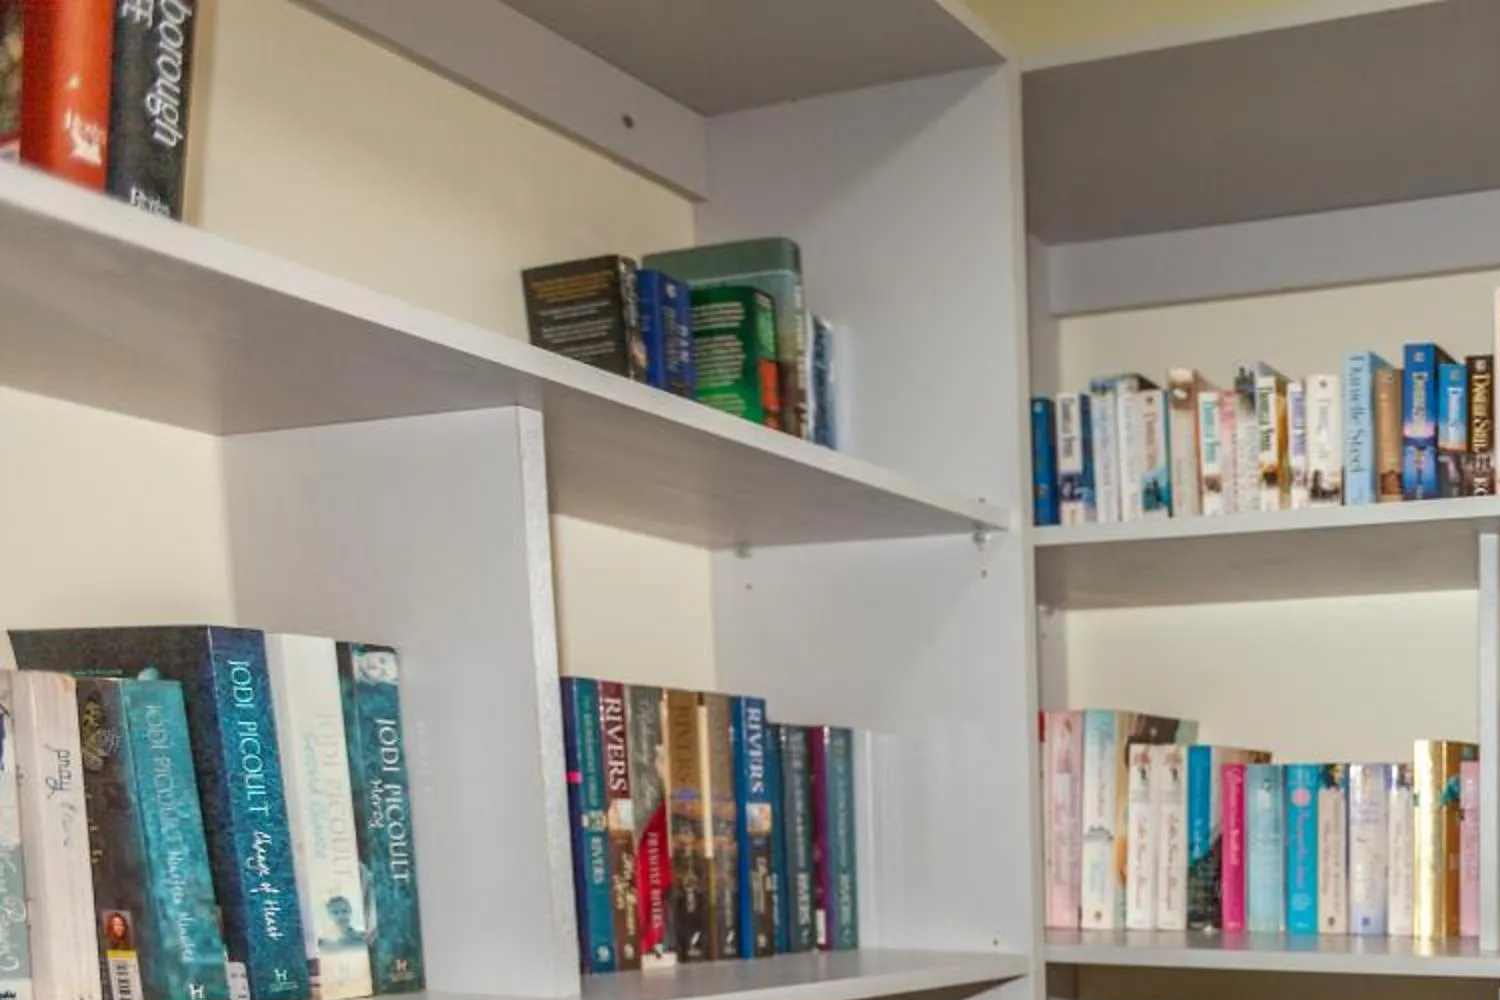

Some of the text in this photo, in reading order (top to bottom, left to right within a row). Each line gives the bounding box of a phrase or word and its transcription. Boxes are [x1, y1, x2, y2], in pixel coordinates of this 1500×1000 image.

[1351, 429, 1368, 472] Steel
[227, 658, 255, 709] JODI
[236, 720, 269, 816] PICOULT
[604, 696, 627, 792] RIVERS
[746, 707, 764, 794] RIVERS
[373, 717, 410, 885] JODI PICOULT
